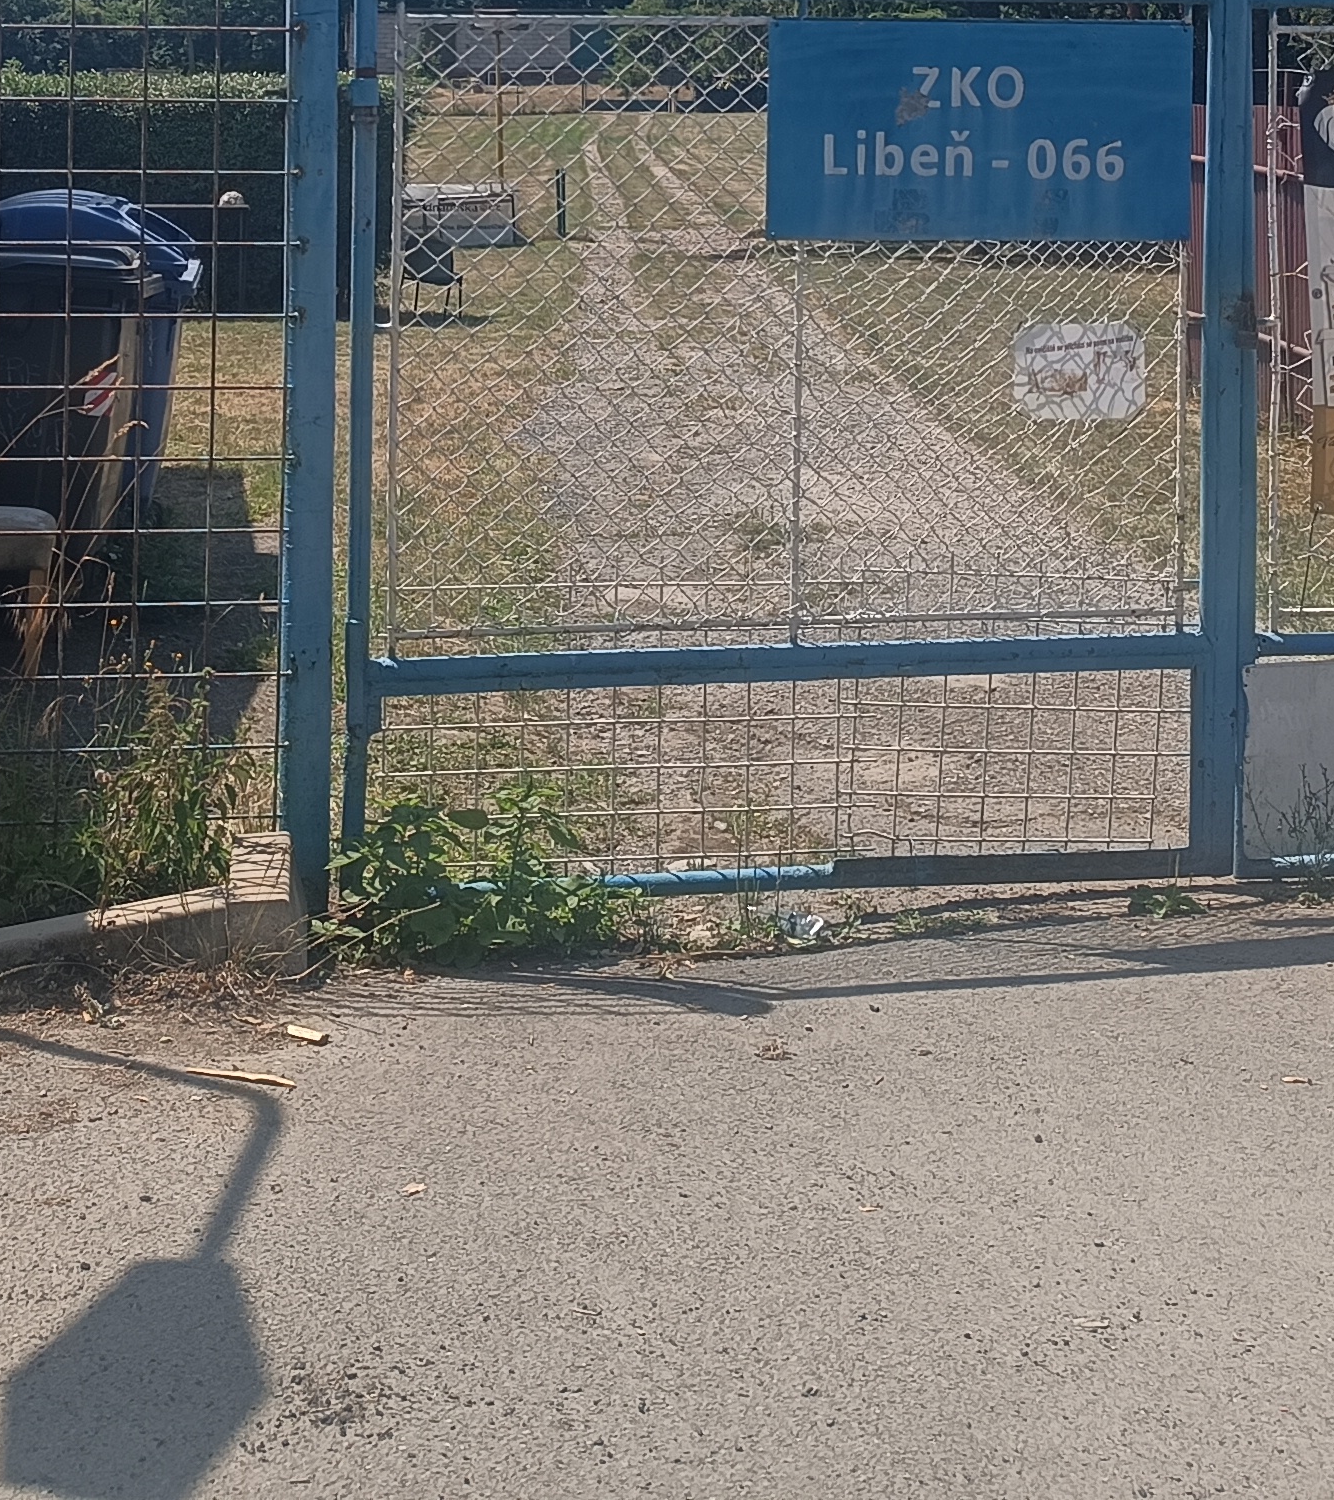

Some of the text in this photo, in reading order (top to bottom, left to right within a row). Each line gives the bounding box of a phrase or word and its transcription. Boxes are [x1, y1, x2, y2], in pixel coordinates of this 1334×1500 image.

[912, 65, 1025, 109] ZKO
[822, 130, 1125, 182] Libeň - 066
